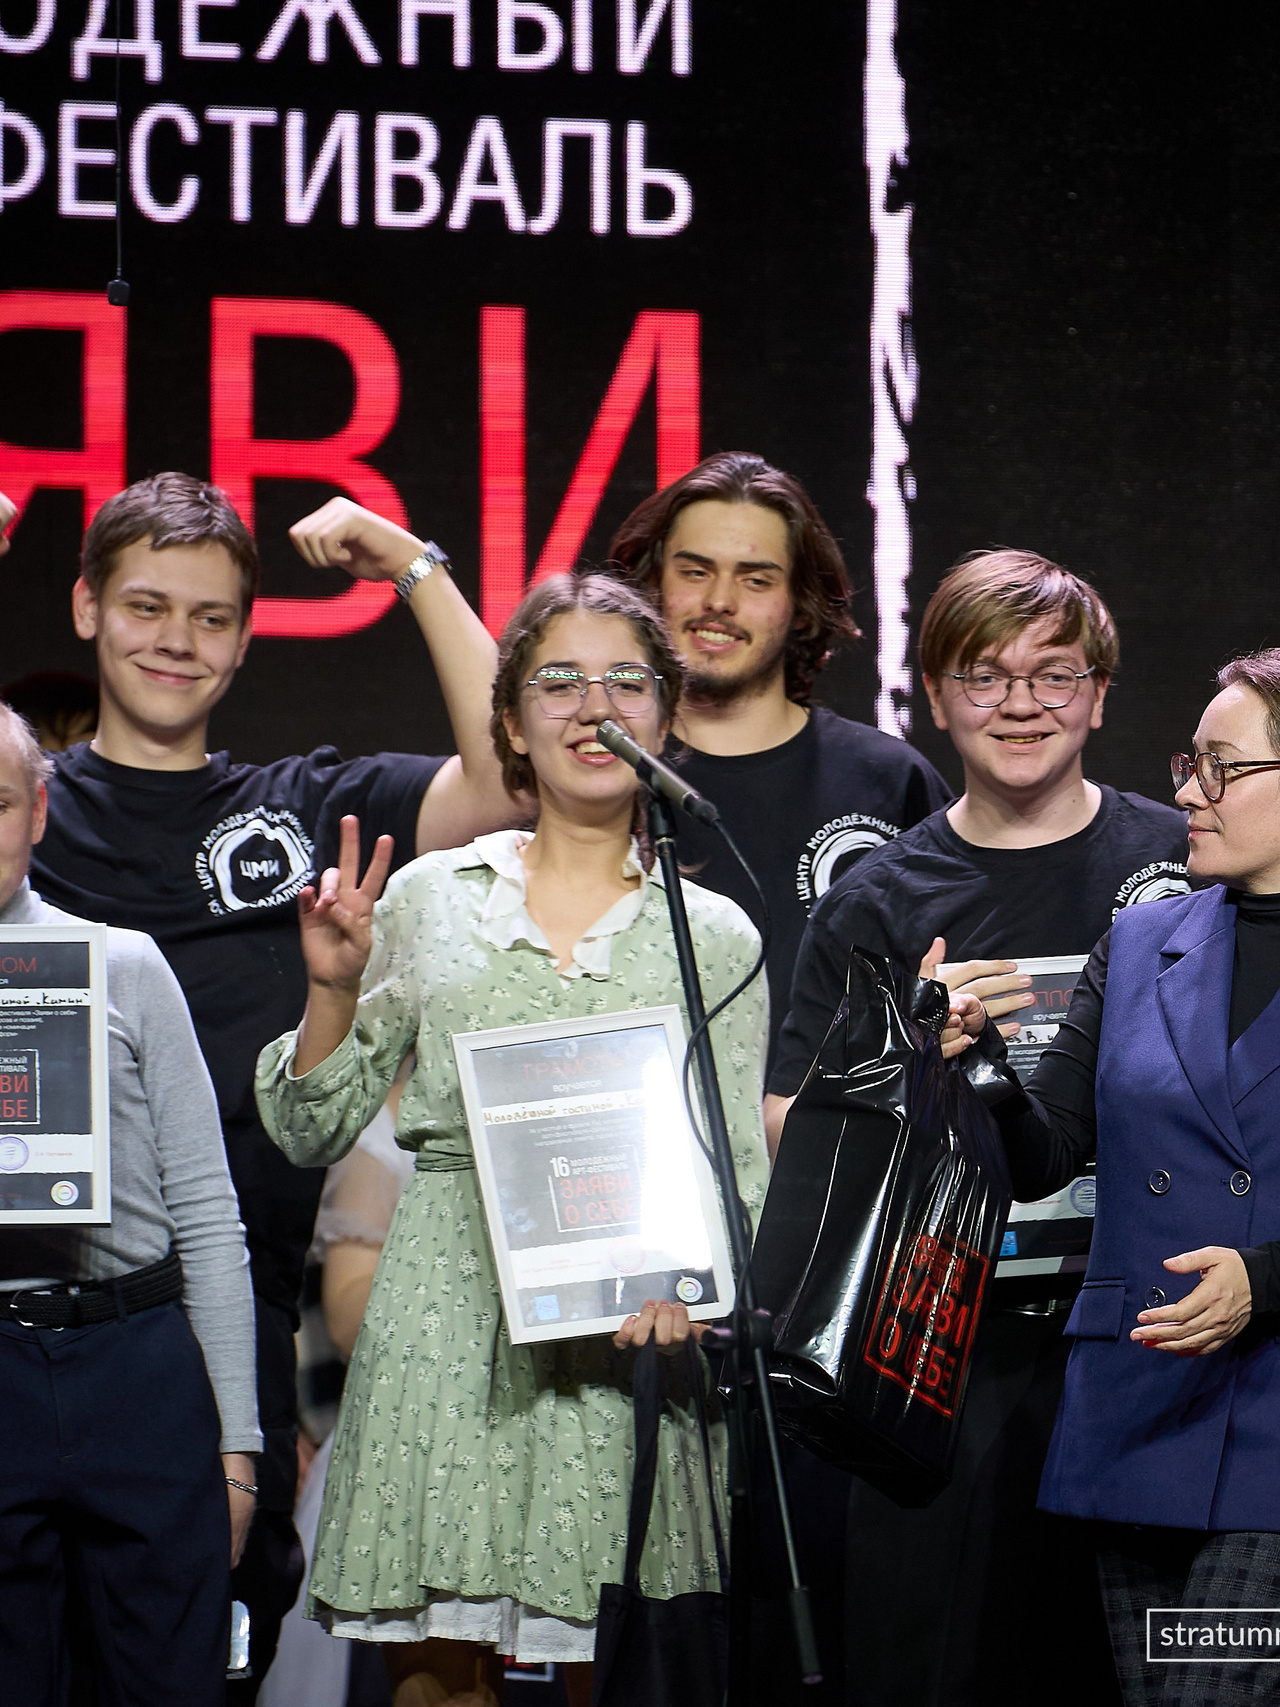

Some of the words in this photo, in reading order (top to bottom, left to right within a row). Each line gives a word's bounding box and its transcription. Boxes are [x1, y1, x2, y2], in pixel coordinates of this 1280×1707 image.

[240, 860, 280, 880] ЦМИ
[796, 853, 811, 900] ЦЕНТР
[550, 1155, 571, 1178] 16
[559, 1171, 634, 1200] ЗАЯВИ
[564, 1204, 580, 1225] О
[585, 1197, 639, 1223] СЕБЕ
[879, 1315, 903, 1360] О
